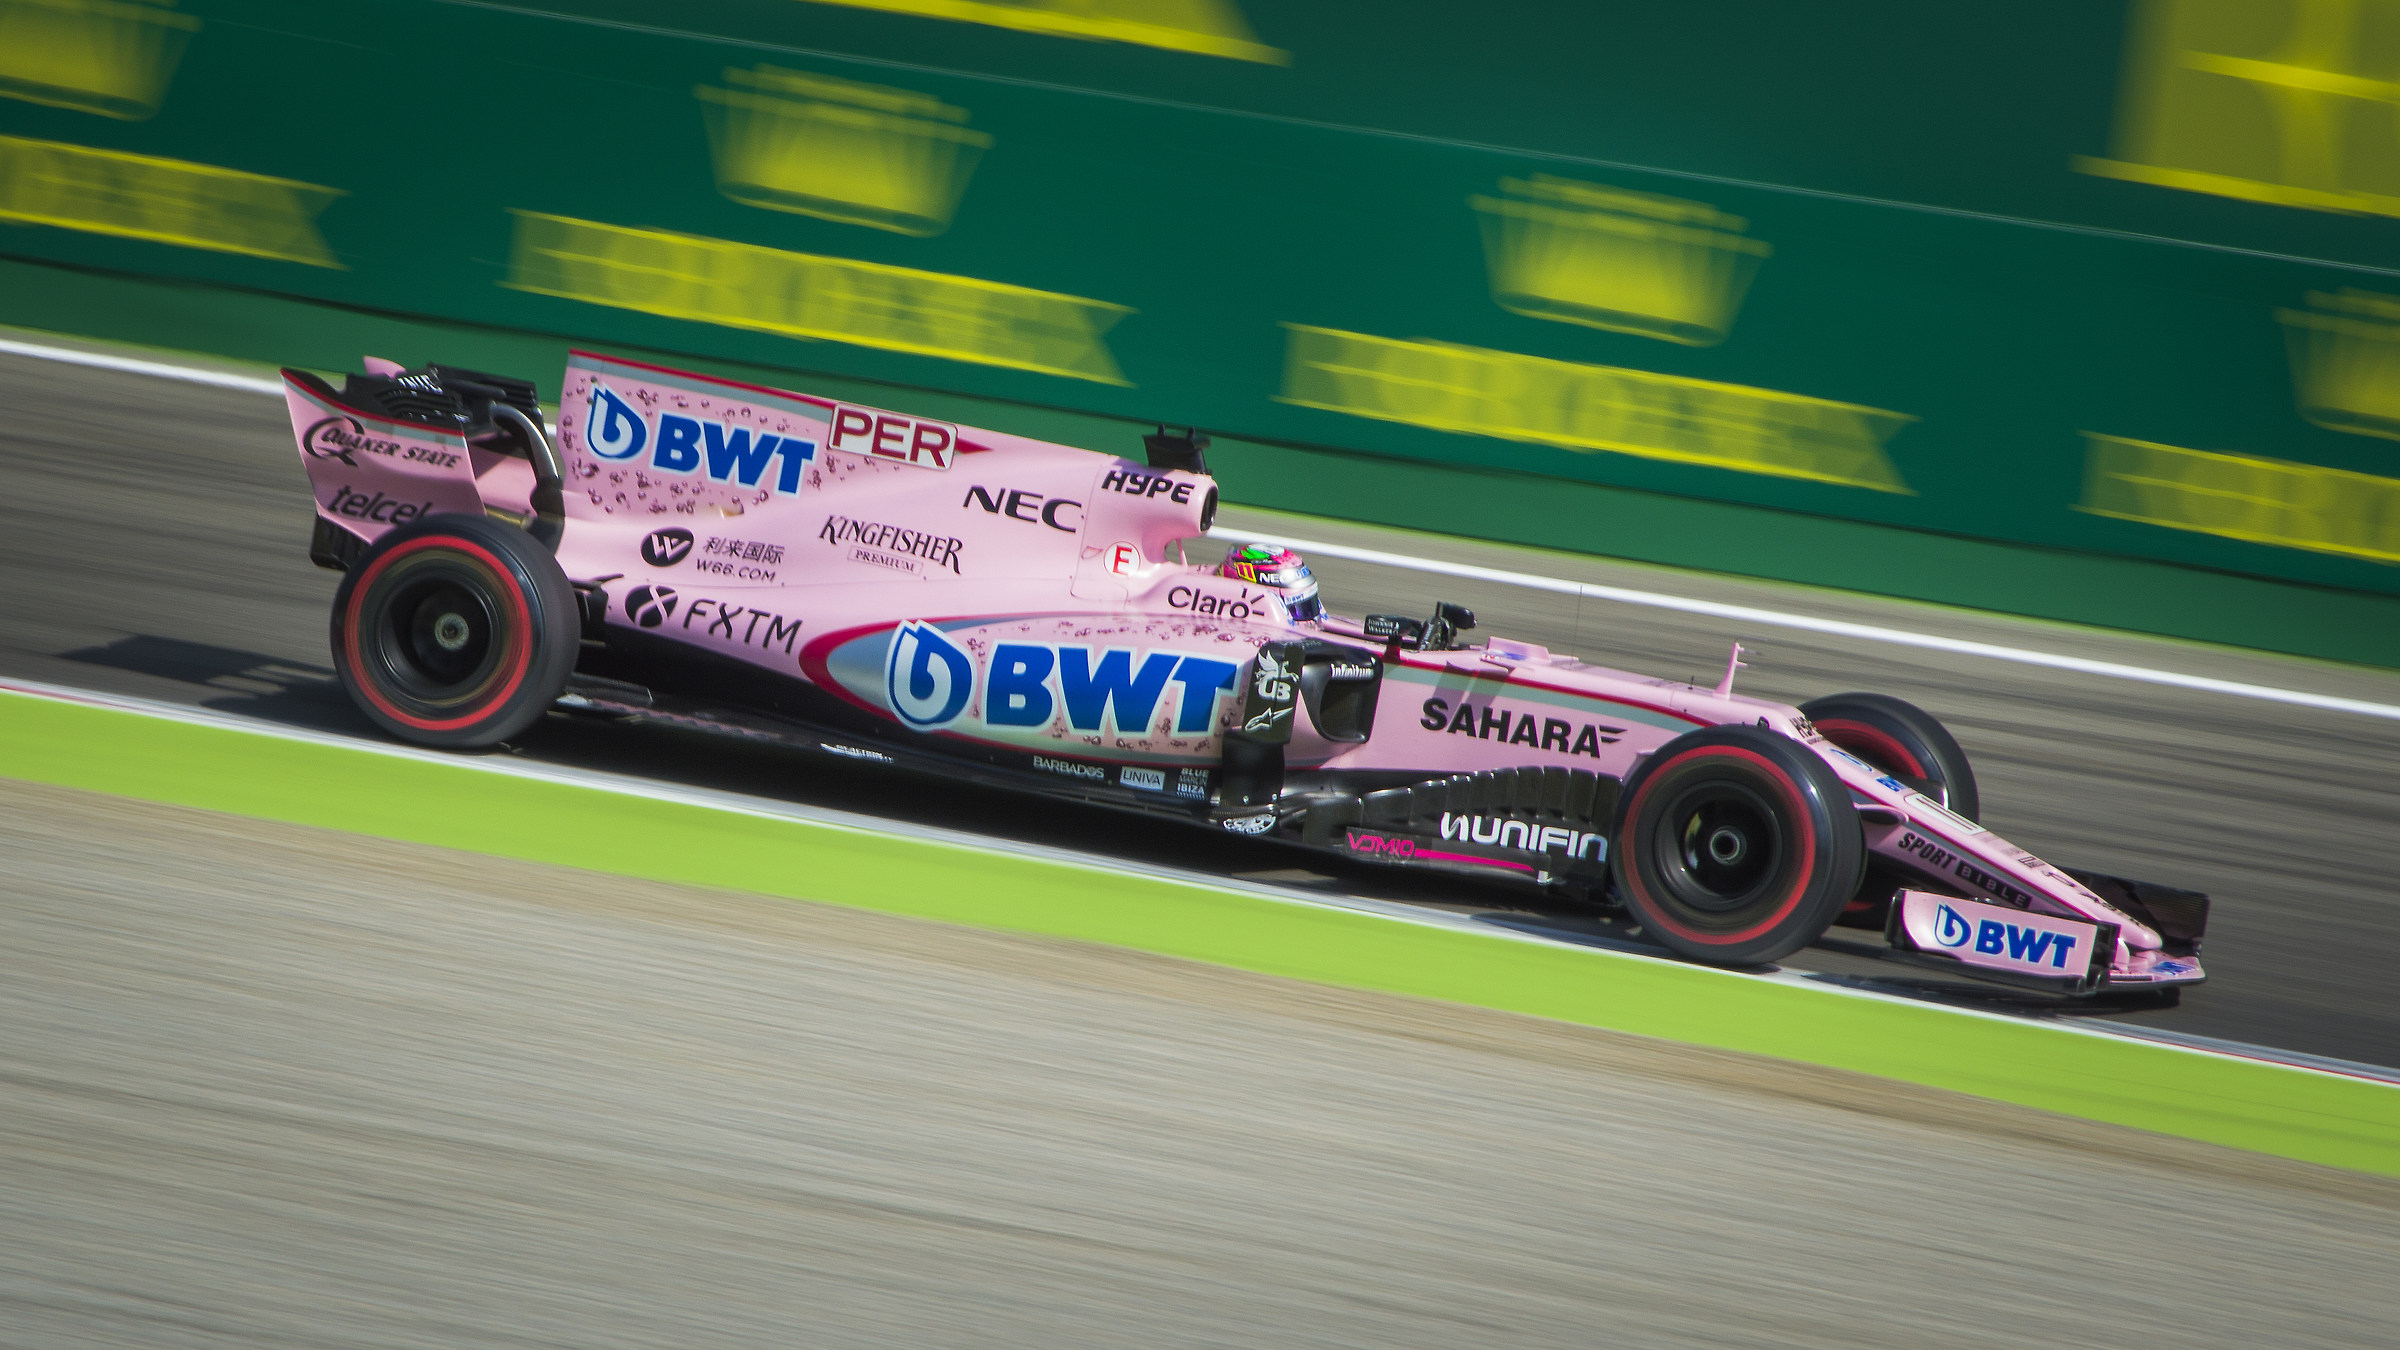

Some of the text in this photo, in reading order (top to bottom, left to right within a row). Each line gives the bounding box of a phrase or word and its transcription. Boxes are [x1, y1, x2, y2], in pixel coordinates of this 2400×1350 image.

[312, 427, 462, 469] QUAKER STATE
[653, 412, 816, 494] BWT
[833, 410, 951, 468] PER
[327, 484, 433, 525] telcel
[1101, 470, 1196, 505] HYPE
[963, 485, 1082, 533] NEC
[819, 515, 965, 575] KINGFISHER
[855, 549, 915, 572] PREMIUM
[1113, 545, 1132, 575] E
[697, 558, 776, 582] W66.COM
[1168, 586, 1249, 618] Claro
[683, 598, 803, 655] FXTM
[986, 643, 1238, 733] BWT
[1258, 679, 1291, 700] UB
[1420, 697, 1601, 758] SAHARA
[1033, 755, 1105, 779] BARBADOS
[1177, 783, 1205, 795] IBIZA
[1898, 832, 2026, 908] SPORT BIBLE
[1975, 918, 2077, 968] BWT
